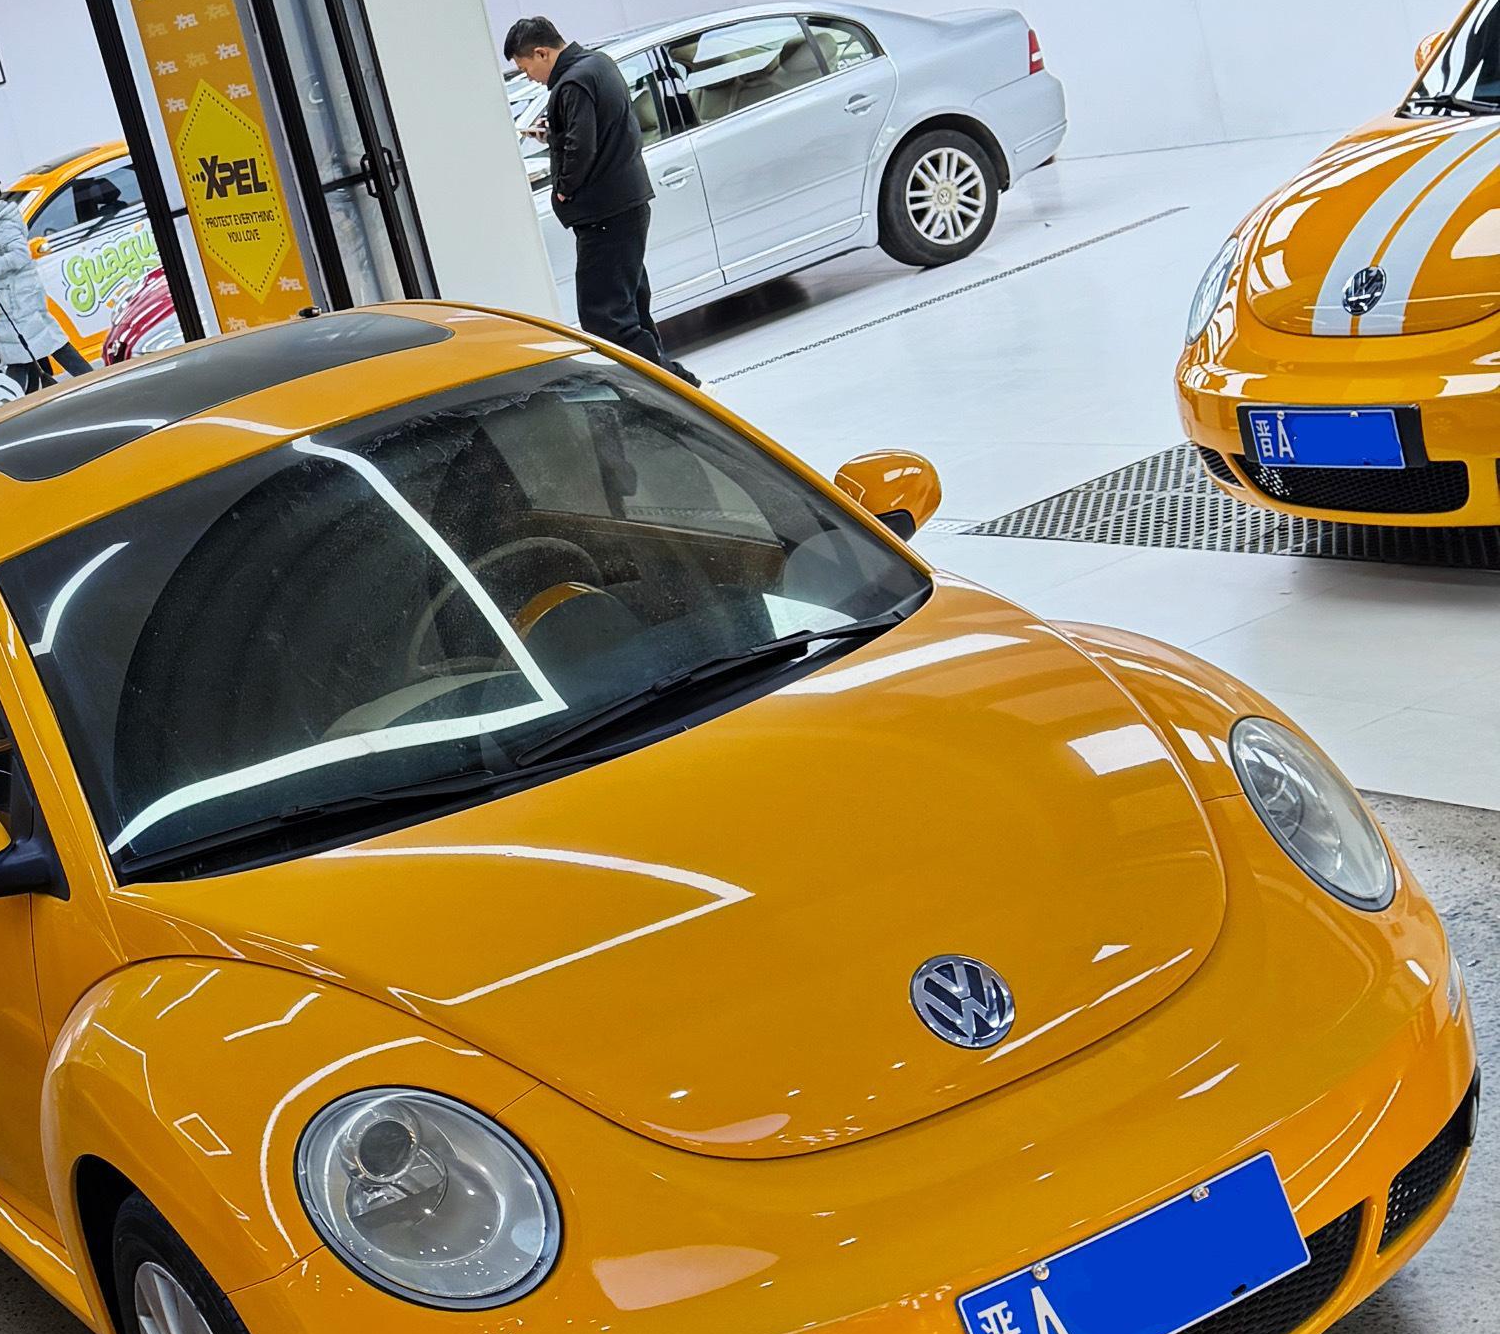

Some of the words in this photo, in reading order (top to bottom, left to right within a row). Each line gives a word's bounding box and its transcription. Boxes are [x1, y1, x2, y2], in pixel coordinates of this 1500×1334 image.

[198, 155, 268, 200] XPEL
[205, 213, 233, 229] PROTECT
[234, 210, 275, 227] EVERYTHING
[227, 231, 242, 243] YOU
[243, 229, 261, 242] LOVE
[1255, 419, 1294, 459] 晋A
